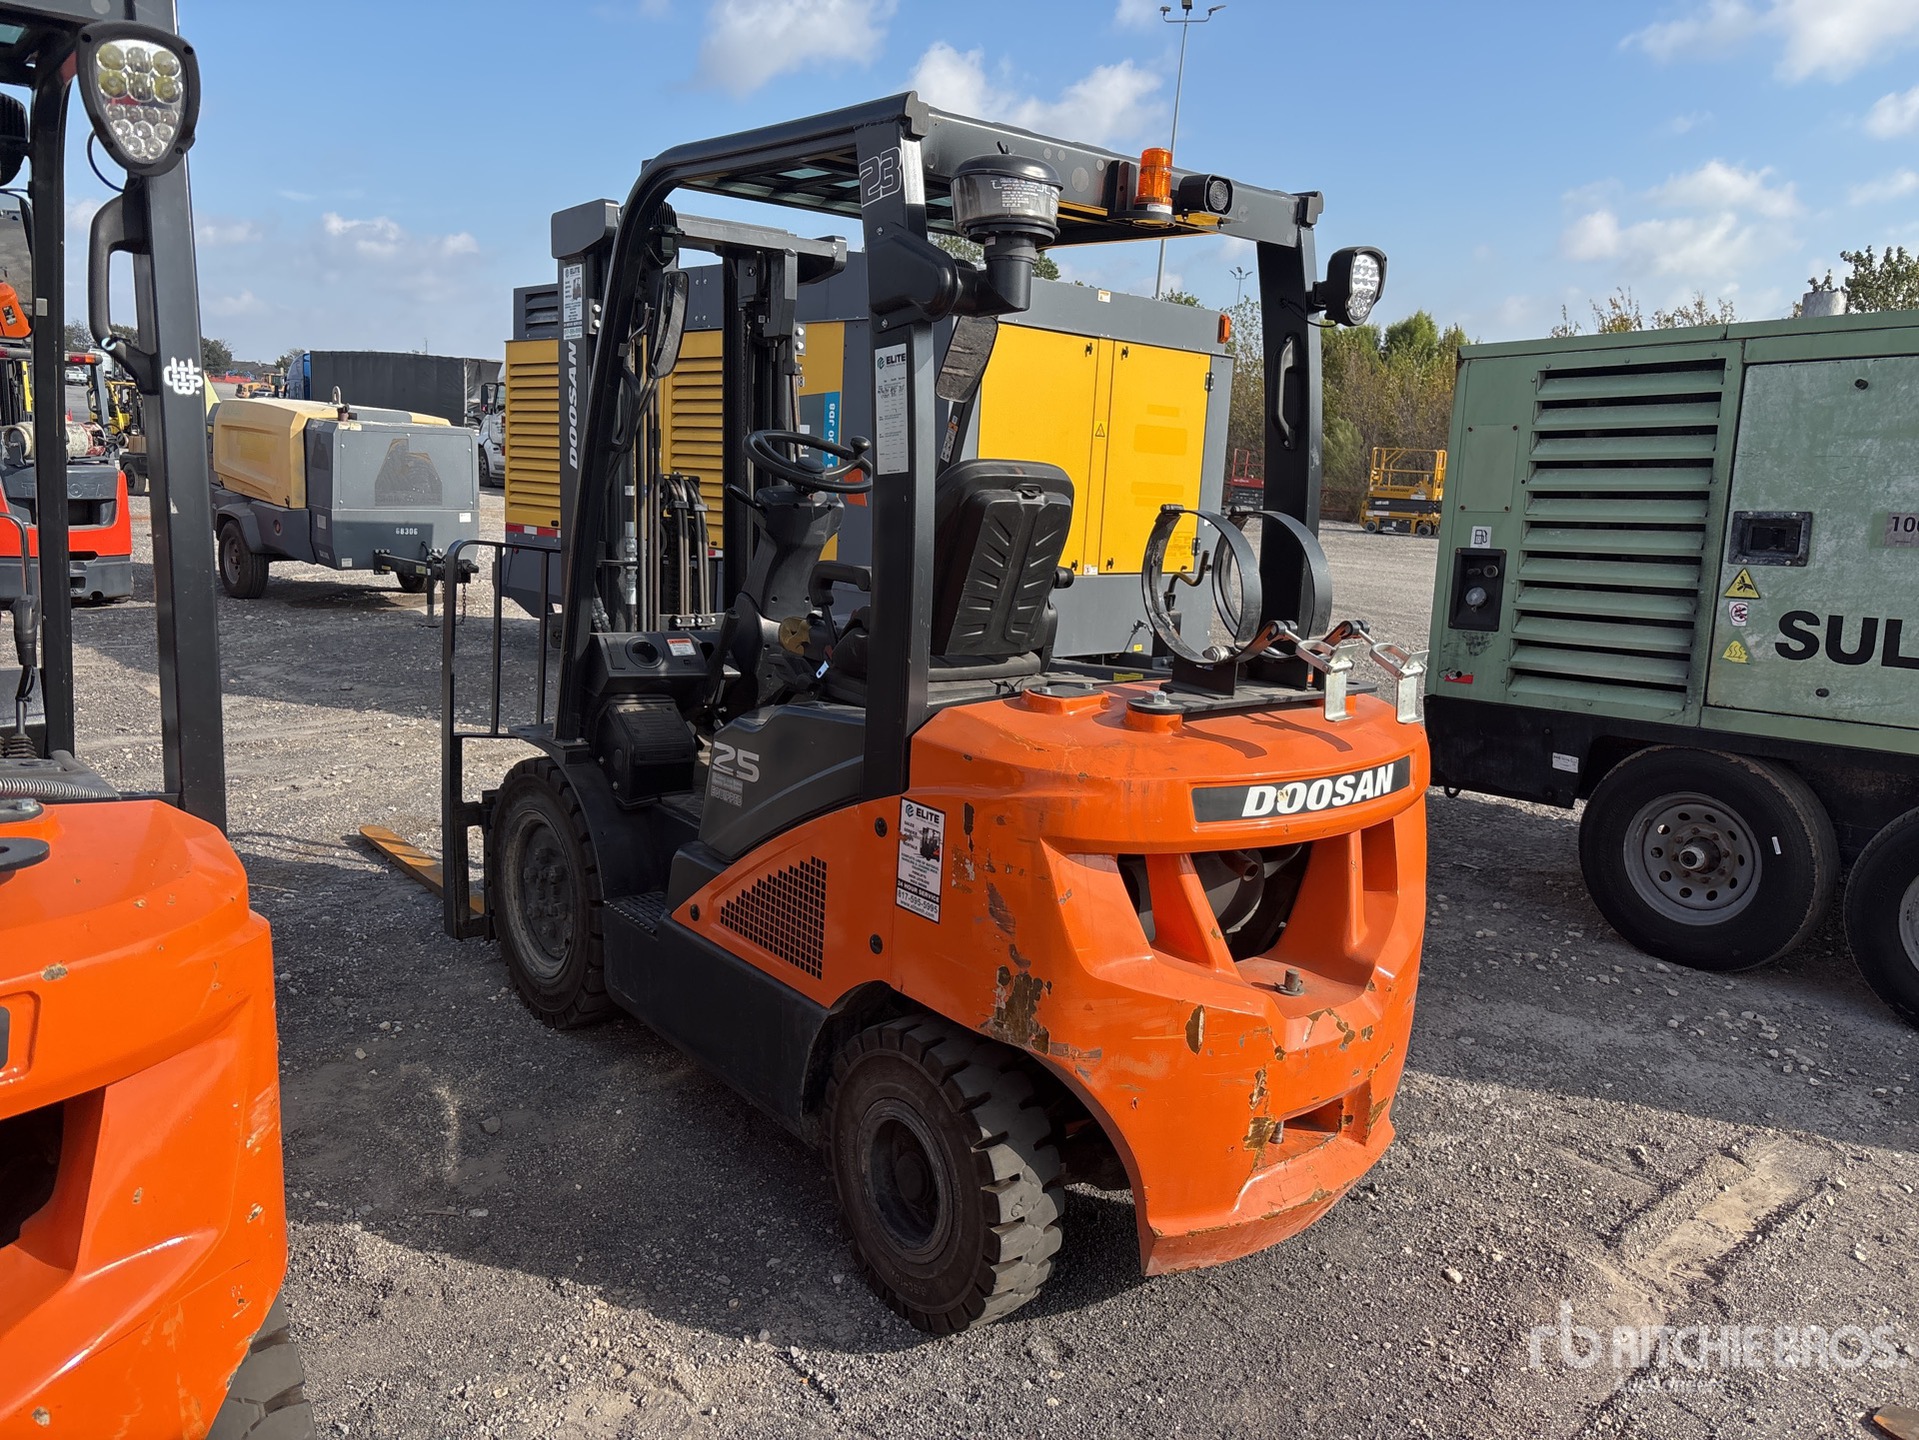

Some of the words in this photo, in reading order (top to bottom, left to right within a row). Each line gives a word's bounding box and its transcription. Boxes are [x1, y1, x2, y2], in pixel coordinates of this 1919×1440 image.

[859, 146, 902, 208] 23
[886, 353, 906, 365] ELITE
[568, 341, 578, 470] DOOSAN
[1892, 516, 1919, 533] 10
[1775, 610, 1919, 670] SUL
[712, 741, 760, 783] 25
[1241, 763, 1395, 818] DOOSAN
[916, 807, 940, 824] ELITE
[903, 882, 918, 894] HOUR
[918, 888, 940, 903] SERVICE
